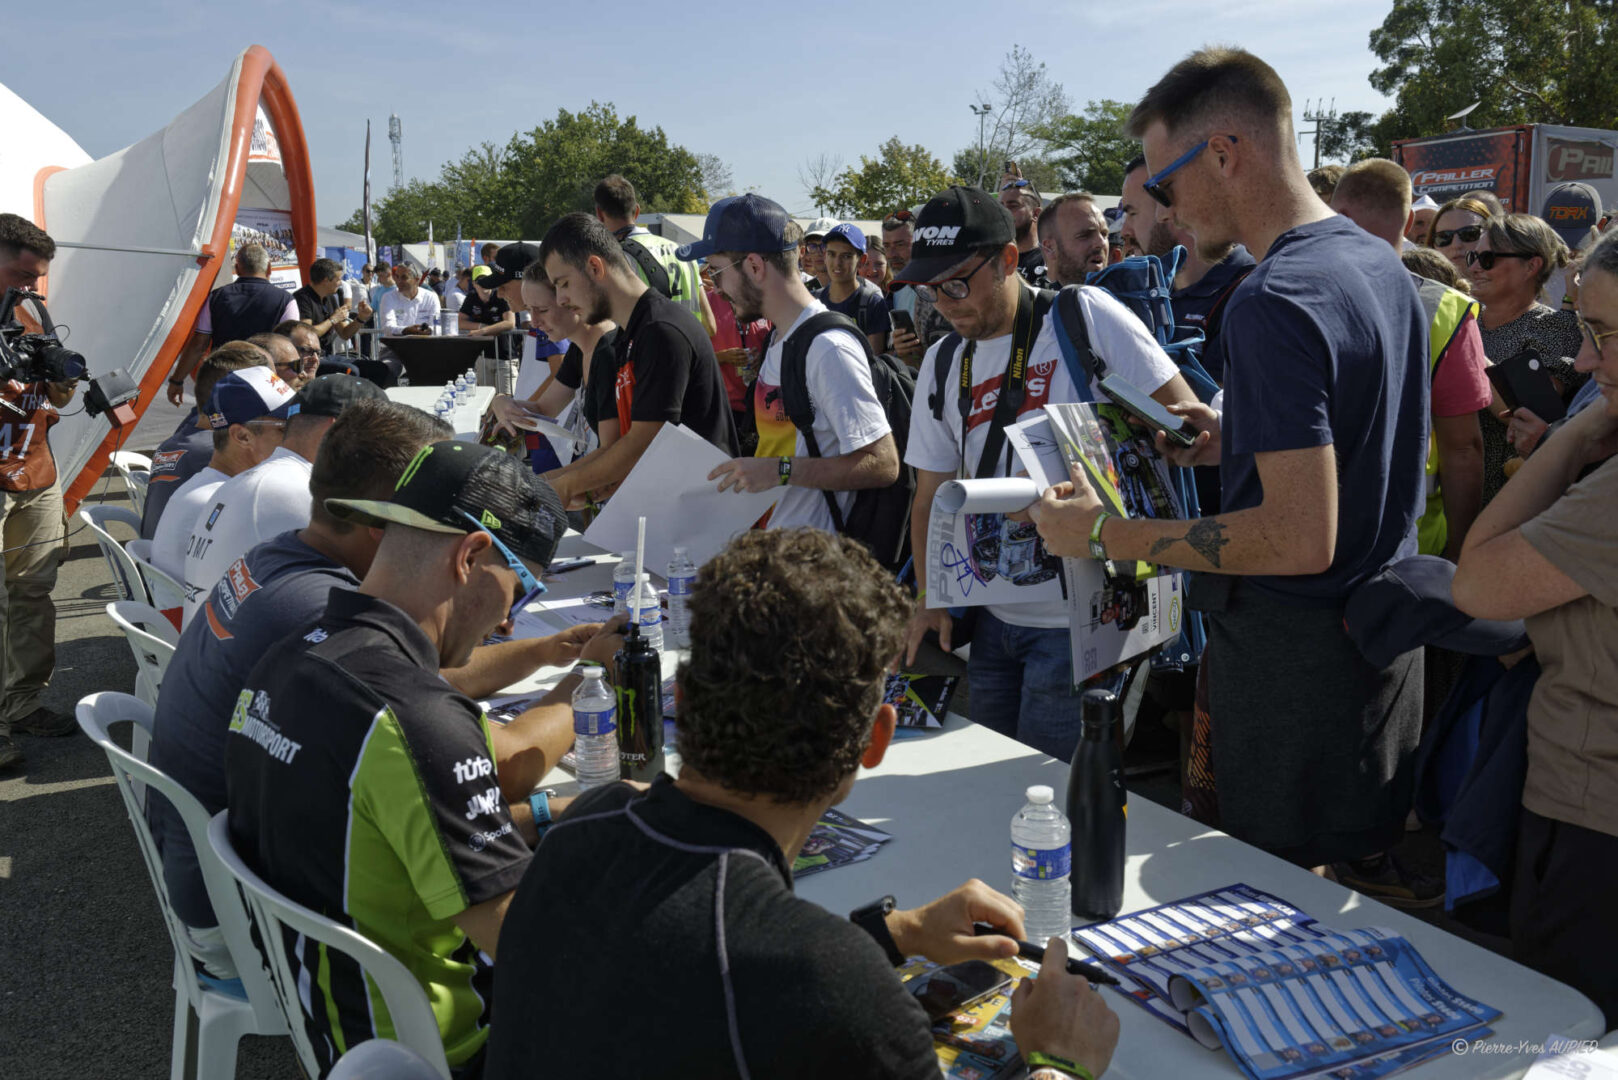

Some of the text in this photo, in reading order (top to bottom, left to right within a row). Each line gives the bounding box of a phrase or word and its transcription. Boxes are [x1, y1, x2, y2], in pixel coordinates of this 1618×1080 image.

[1421, 168, 1495, 184] PAILLER
[1550, 206, 1589, 220] TORX
[961, 358, 969, 387] Nikon
[1013, 348, 1024, 379] Nikon
[241, 715, 302, 764] MOTORSPORT
